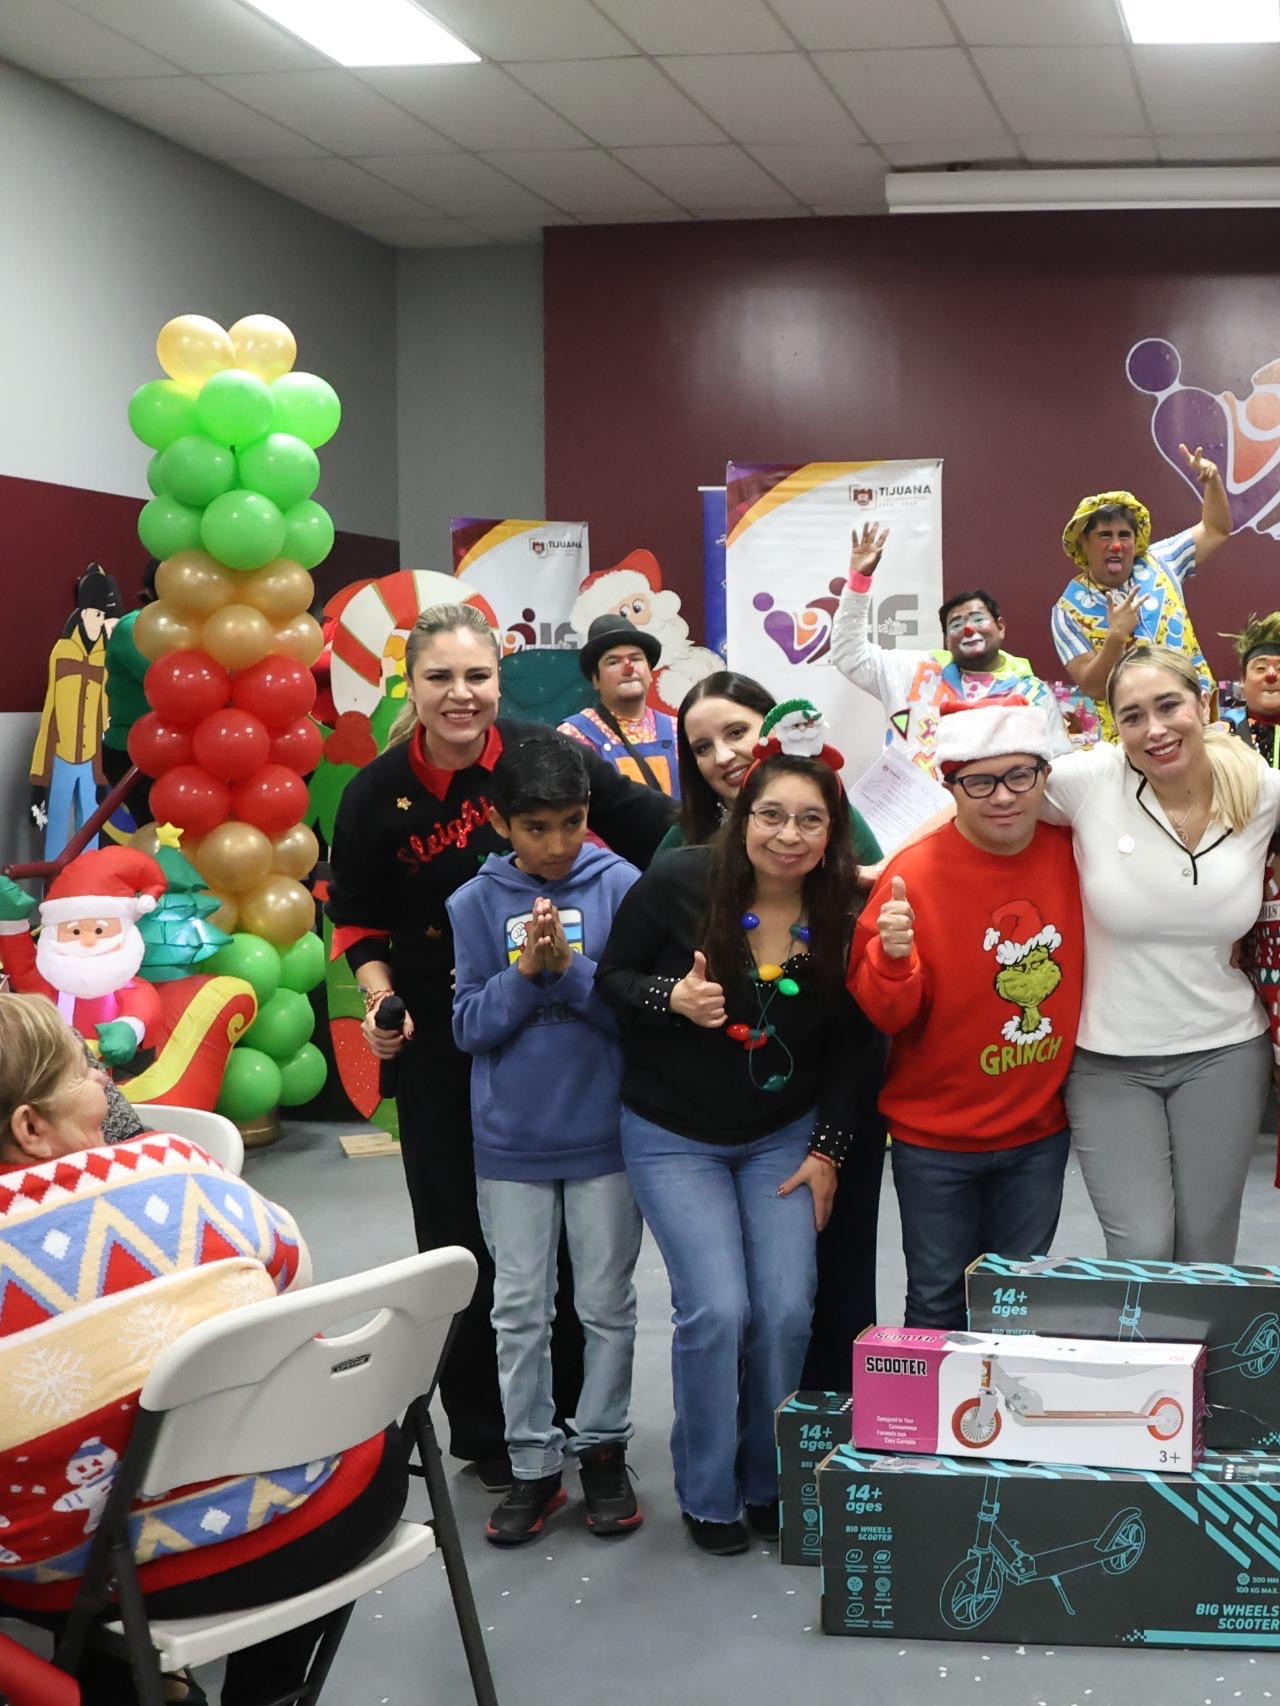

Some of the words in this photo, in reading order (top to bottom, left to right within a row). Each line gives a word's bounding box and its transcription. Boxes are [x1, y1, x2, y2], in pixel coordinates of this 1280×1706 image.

[878, 484, 932, 497] TIJUANA
[979, 1035, 1063, 1076] GRINCH
[992, 1287, 1028, 1305] 14+
[991, 1304, 1029, 1318] ages
[865, 1356, 928, 1376] SCOOTER
[799, 1424, 833, 1440] 14+
[799, 1440, 833, 1452] ages
[1159, 1450, 1182, 1464] 3+
[846, 1484, 883, 1501] 14+
[845, 1501, 883, 1515] ages
[845, 1525, 859, 1533] BIG
[860, 1525, 893, 1534] WHEELS
[857, 1533, 893, 1542] SCOOTER
[1236, 1586, 1249, 1594] 100
[1196, 1603, 1220, 1616] BIG
[1223, 1604, 1280, 1618] WHEELS
[1217, 1617, 1280, 1631] SCOOTER
